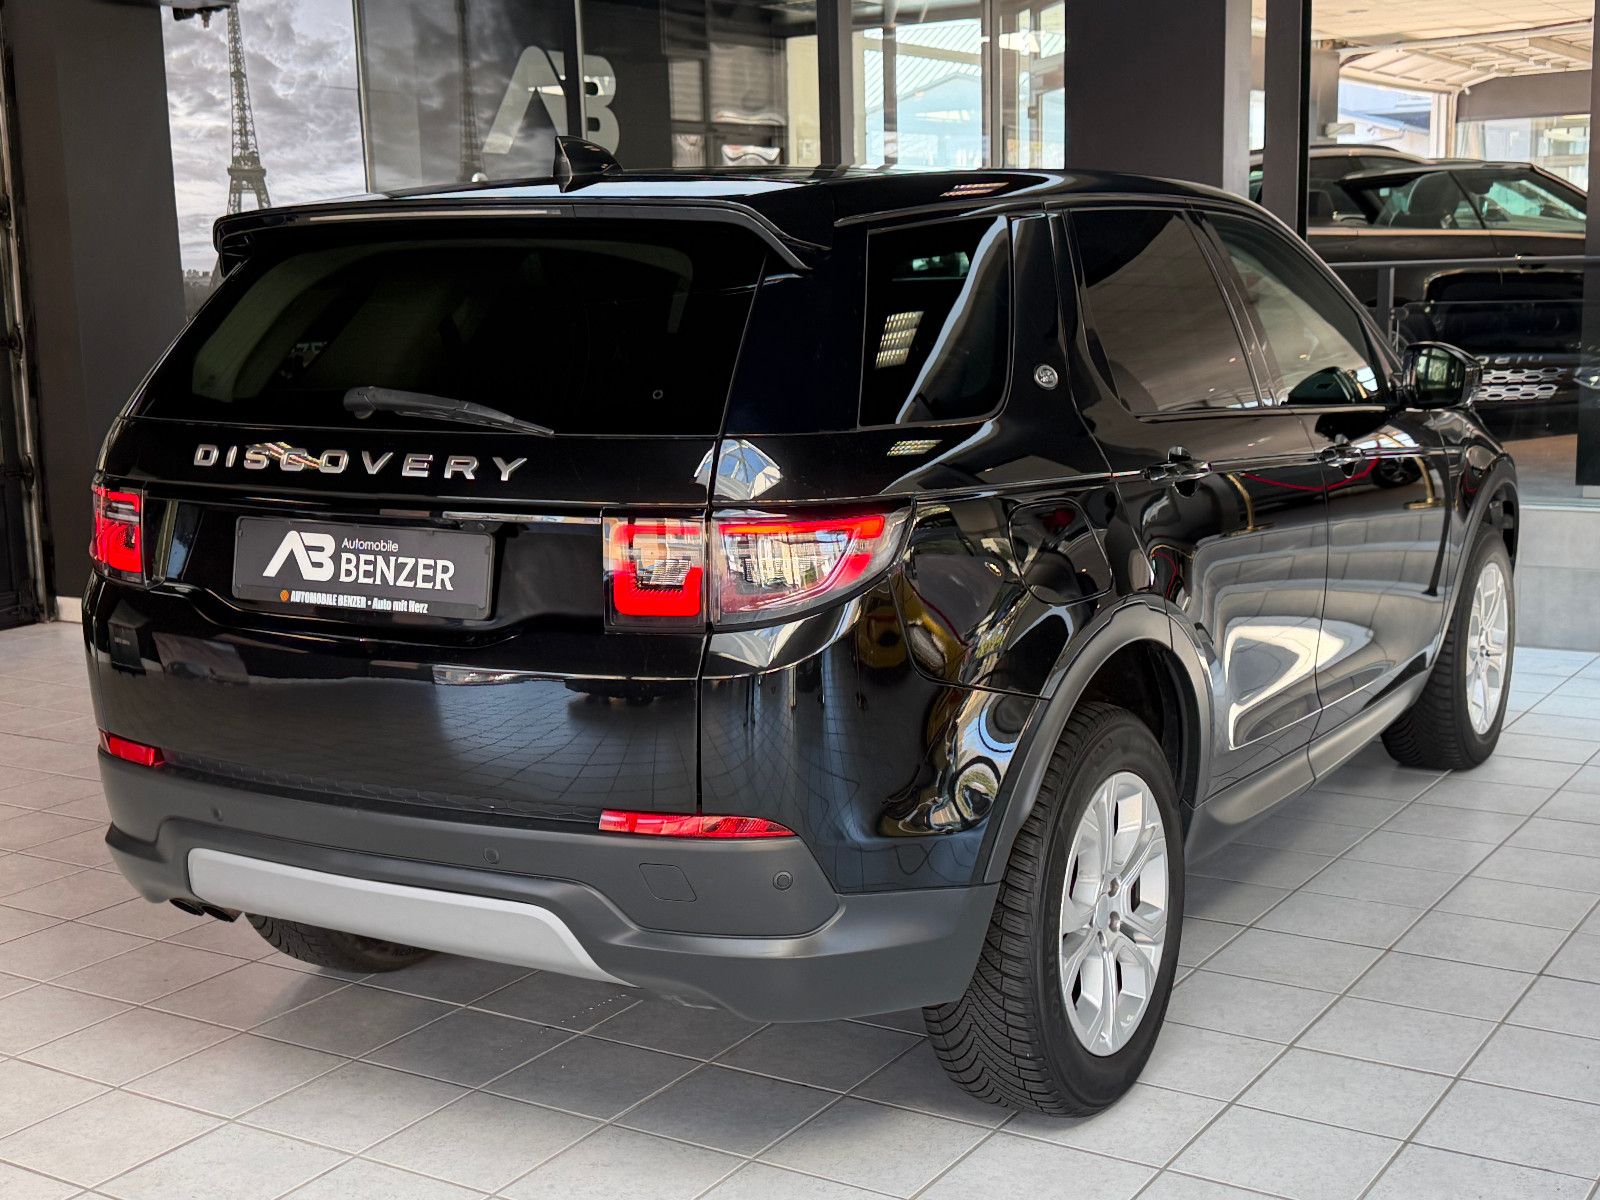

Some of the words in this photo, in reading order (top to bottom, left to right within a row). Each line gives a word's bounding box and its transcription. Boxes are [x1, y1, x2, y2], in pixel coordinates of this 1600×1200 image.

[193, 443, 528, 482] DISCOVERY
[262, 530, 336, 582] AB
[341, 537, 399, 553] Automobile
[339, 552, 455, 591] BENZER
[290, 590, 338, 606] AUTOMOBILE
